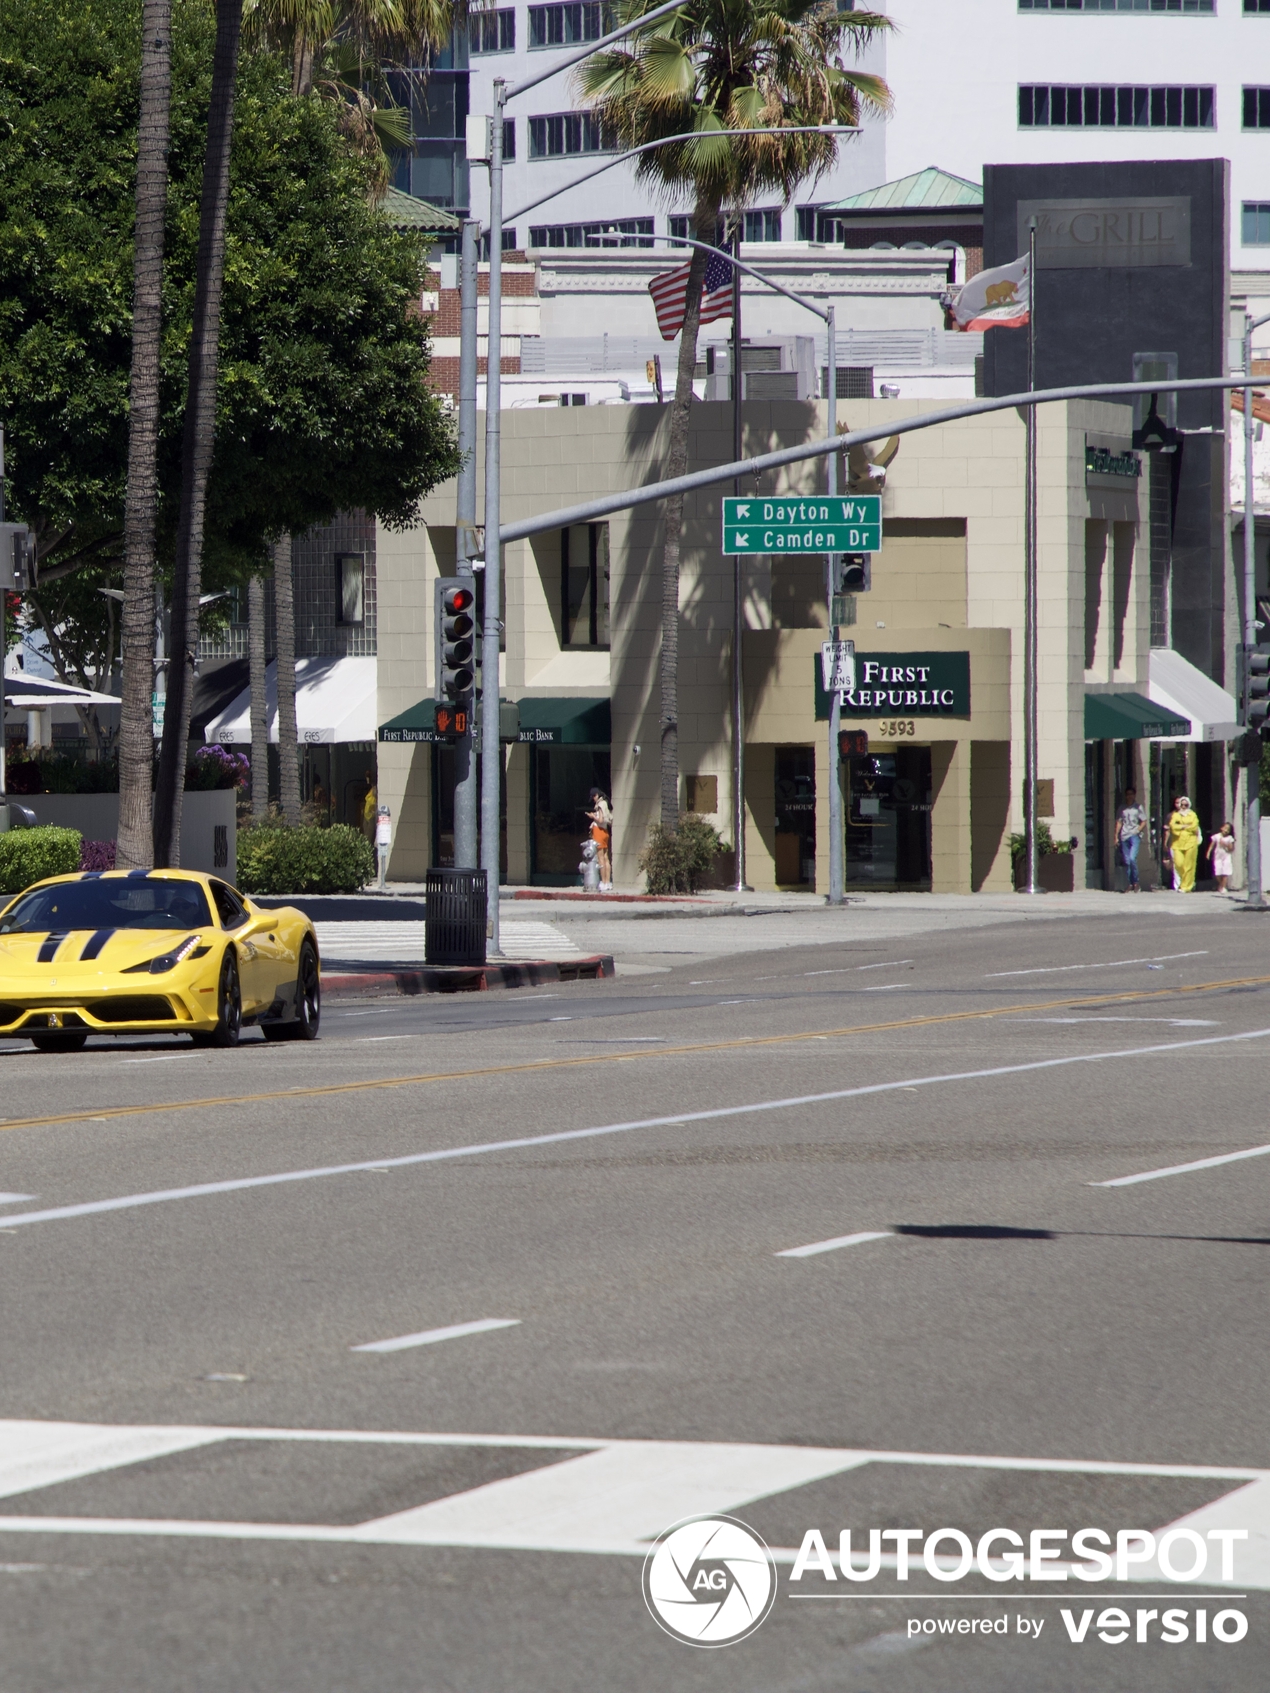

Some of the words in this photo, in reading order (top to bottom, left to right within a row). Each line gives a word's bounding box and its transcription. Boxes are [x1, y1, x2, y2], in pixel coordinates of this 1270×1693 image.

[1069, 212, 1175, 244] GRILL
[764, 503, 828, 523] Dayton
[842, 502, 866, 522] Wy
[764, 530, 835, 547] Camden
[849, 530, 869, 546] Dr
[825, 644, 851, 653] WEIGHT
[829, 653, 847, 662] LIMIT
[836, 665, 843, 674] 5
[863, 661, 930, 683] FIRST
[829, 676, 851, 686] TONS
[839, 689, 954, 707] REPUBLIC
[455, 712, 465, 732] 10
[879, 720, 915, 736] 9593
[383, 729, 401, 741] FIRST
[402, 729, 433, 741] REPUBLIC
[535, 728, 554, 741] BANK
